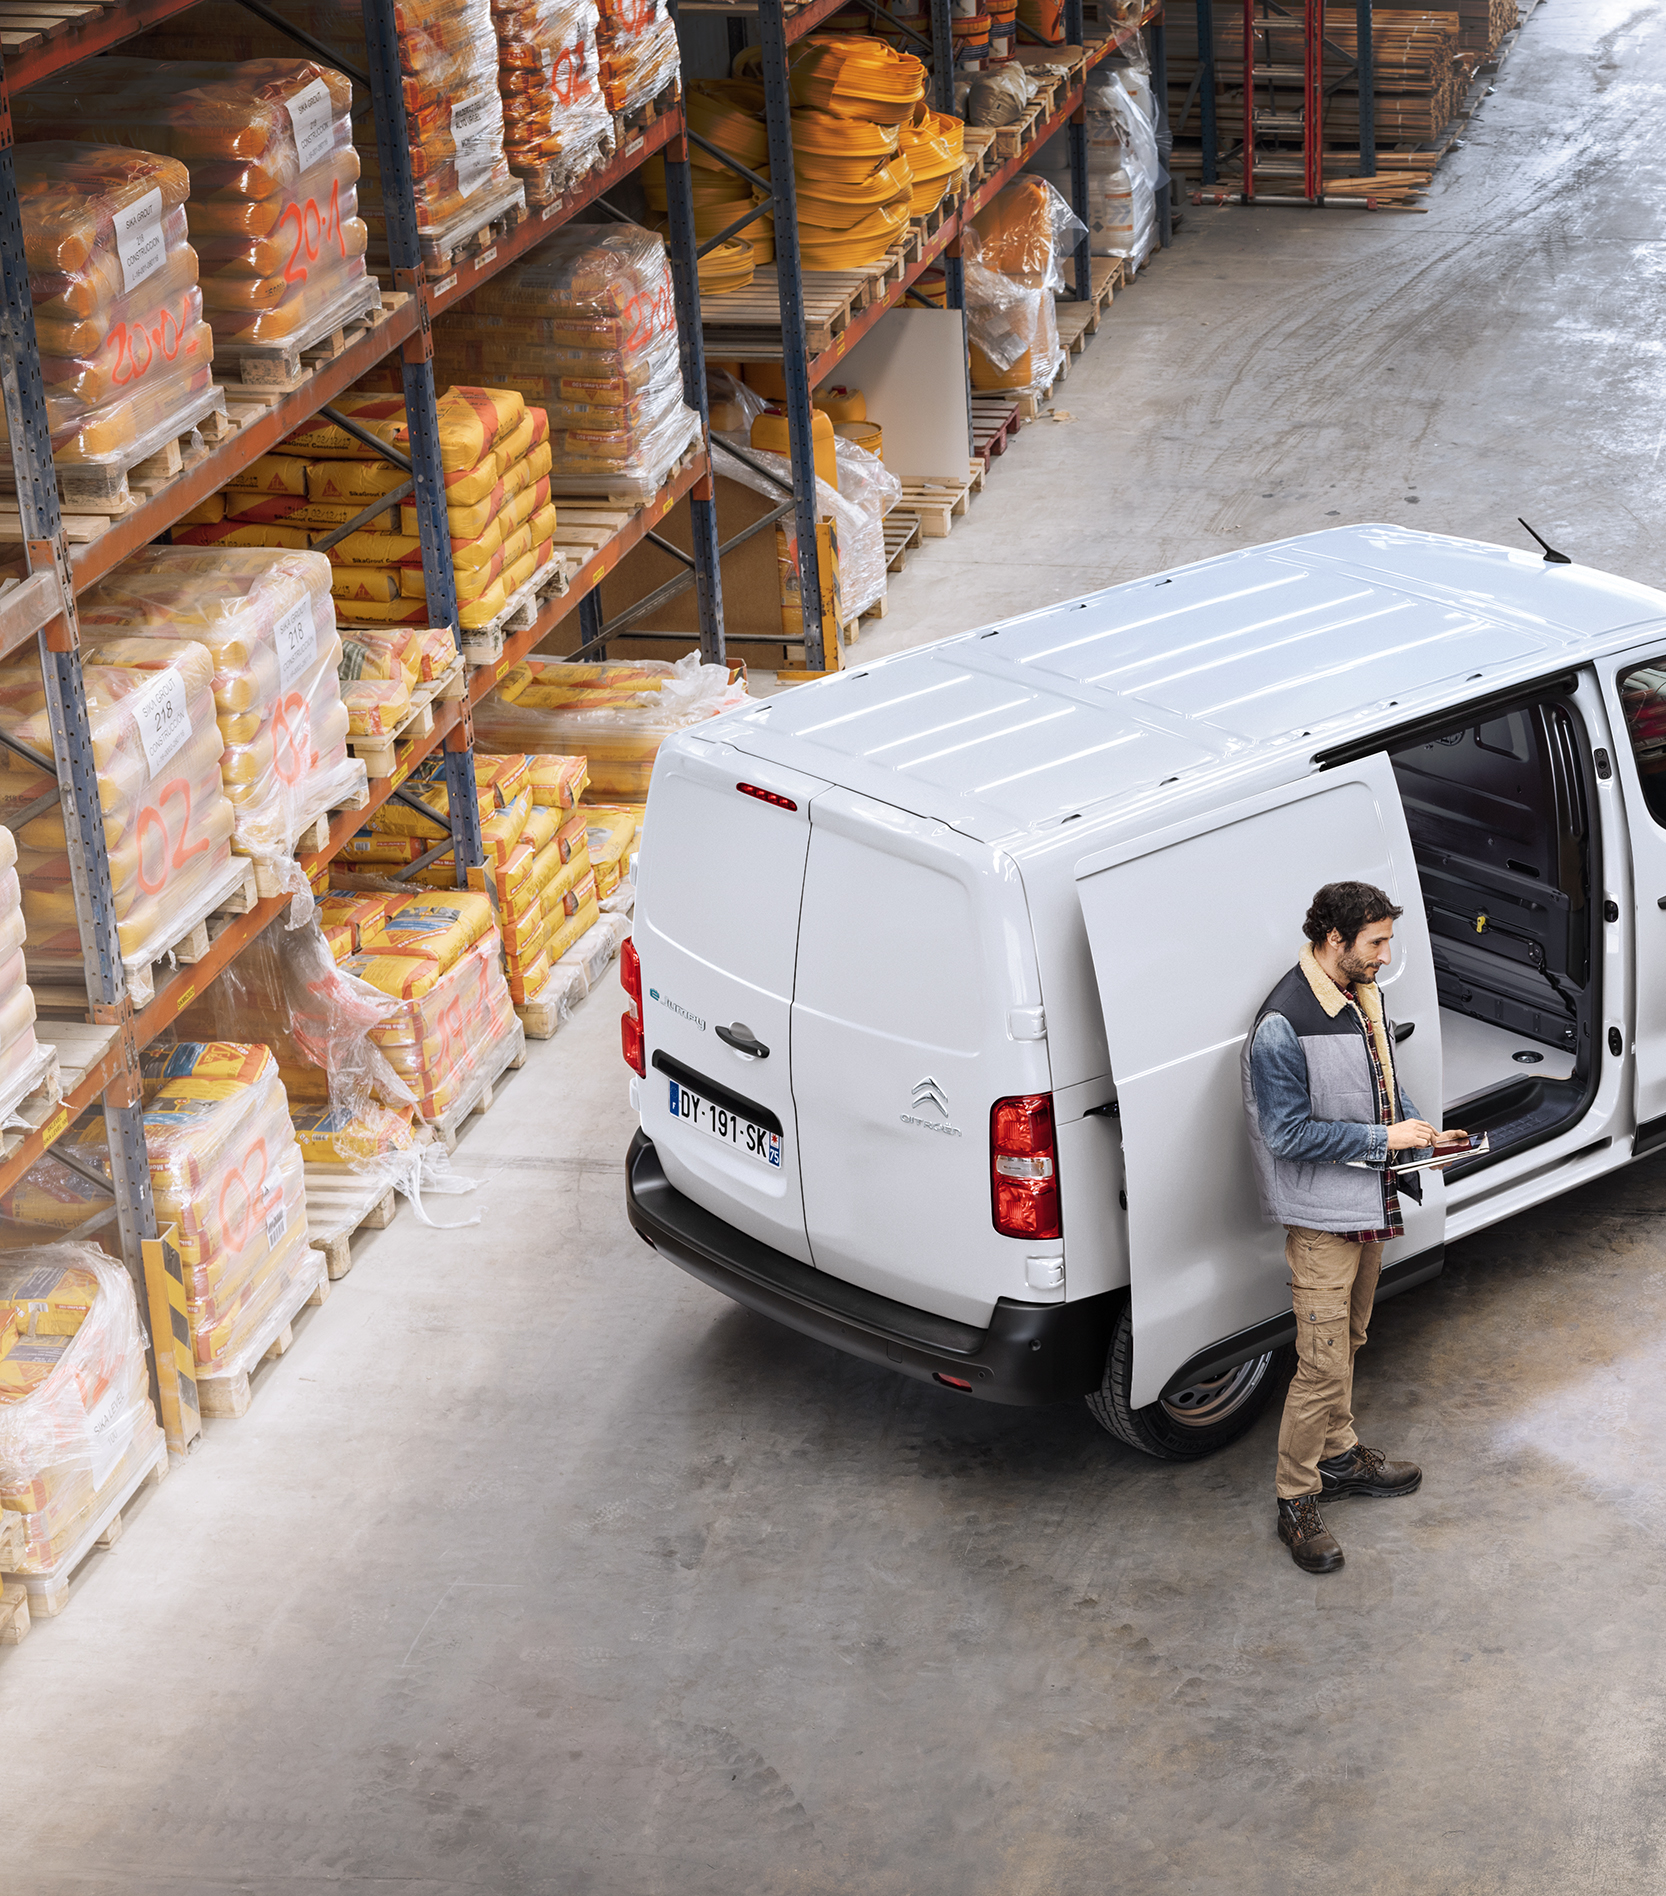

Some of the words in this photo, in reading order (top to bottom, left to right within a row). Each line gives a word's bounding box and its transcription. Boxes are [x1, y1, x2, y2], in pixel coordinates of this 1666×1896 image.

[287, 622, 306, 651] 218
[141, 695, 158, 718] SIKA
[156, 677, 177, 706] GROUT
[153, 699, 175, 733] 218
[135, 777, 211, 896] 02
[672, 1102, 676, 1110] F
[769, 1148, 780, 1165] 75
[218, 1137, 285, 1253] 02
